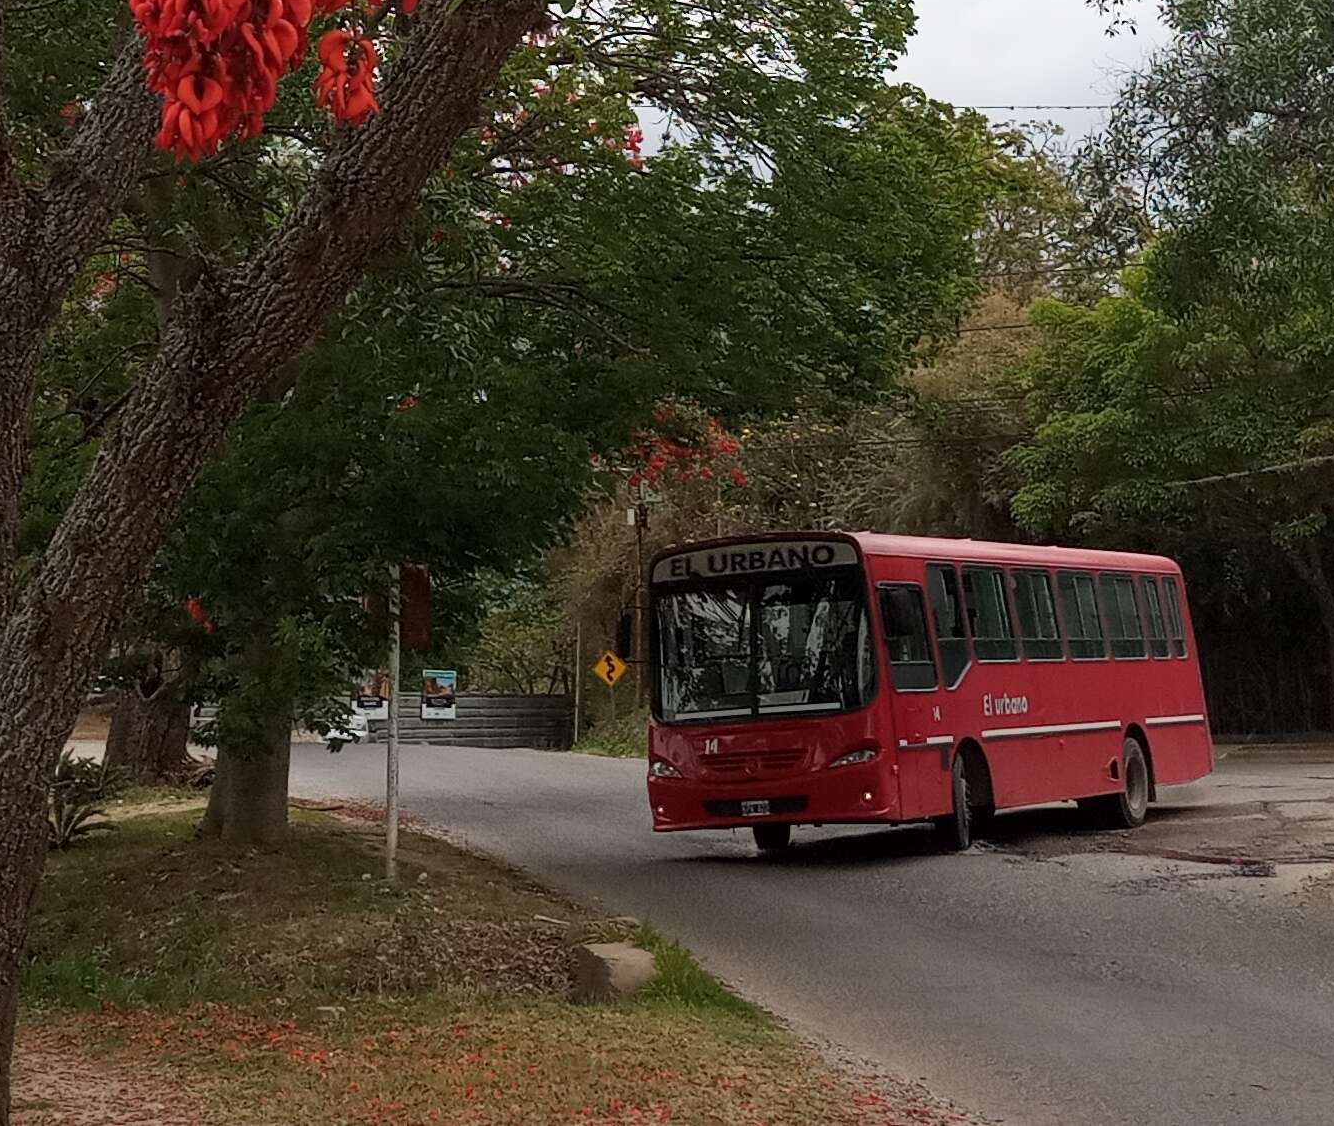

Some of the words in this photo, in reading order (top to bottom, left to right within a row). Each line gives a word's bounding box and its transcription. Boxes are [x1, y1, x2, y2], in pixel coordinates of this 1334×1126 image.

[670, 558, 695, 577] EL
[708, 544, 836, 573] URBANO
[983, 693, 993, 716] El
[994, 693, 1028, 716] urbano
[704, 738, 719, 755] 14
